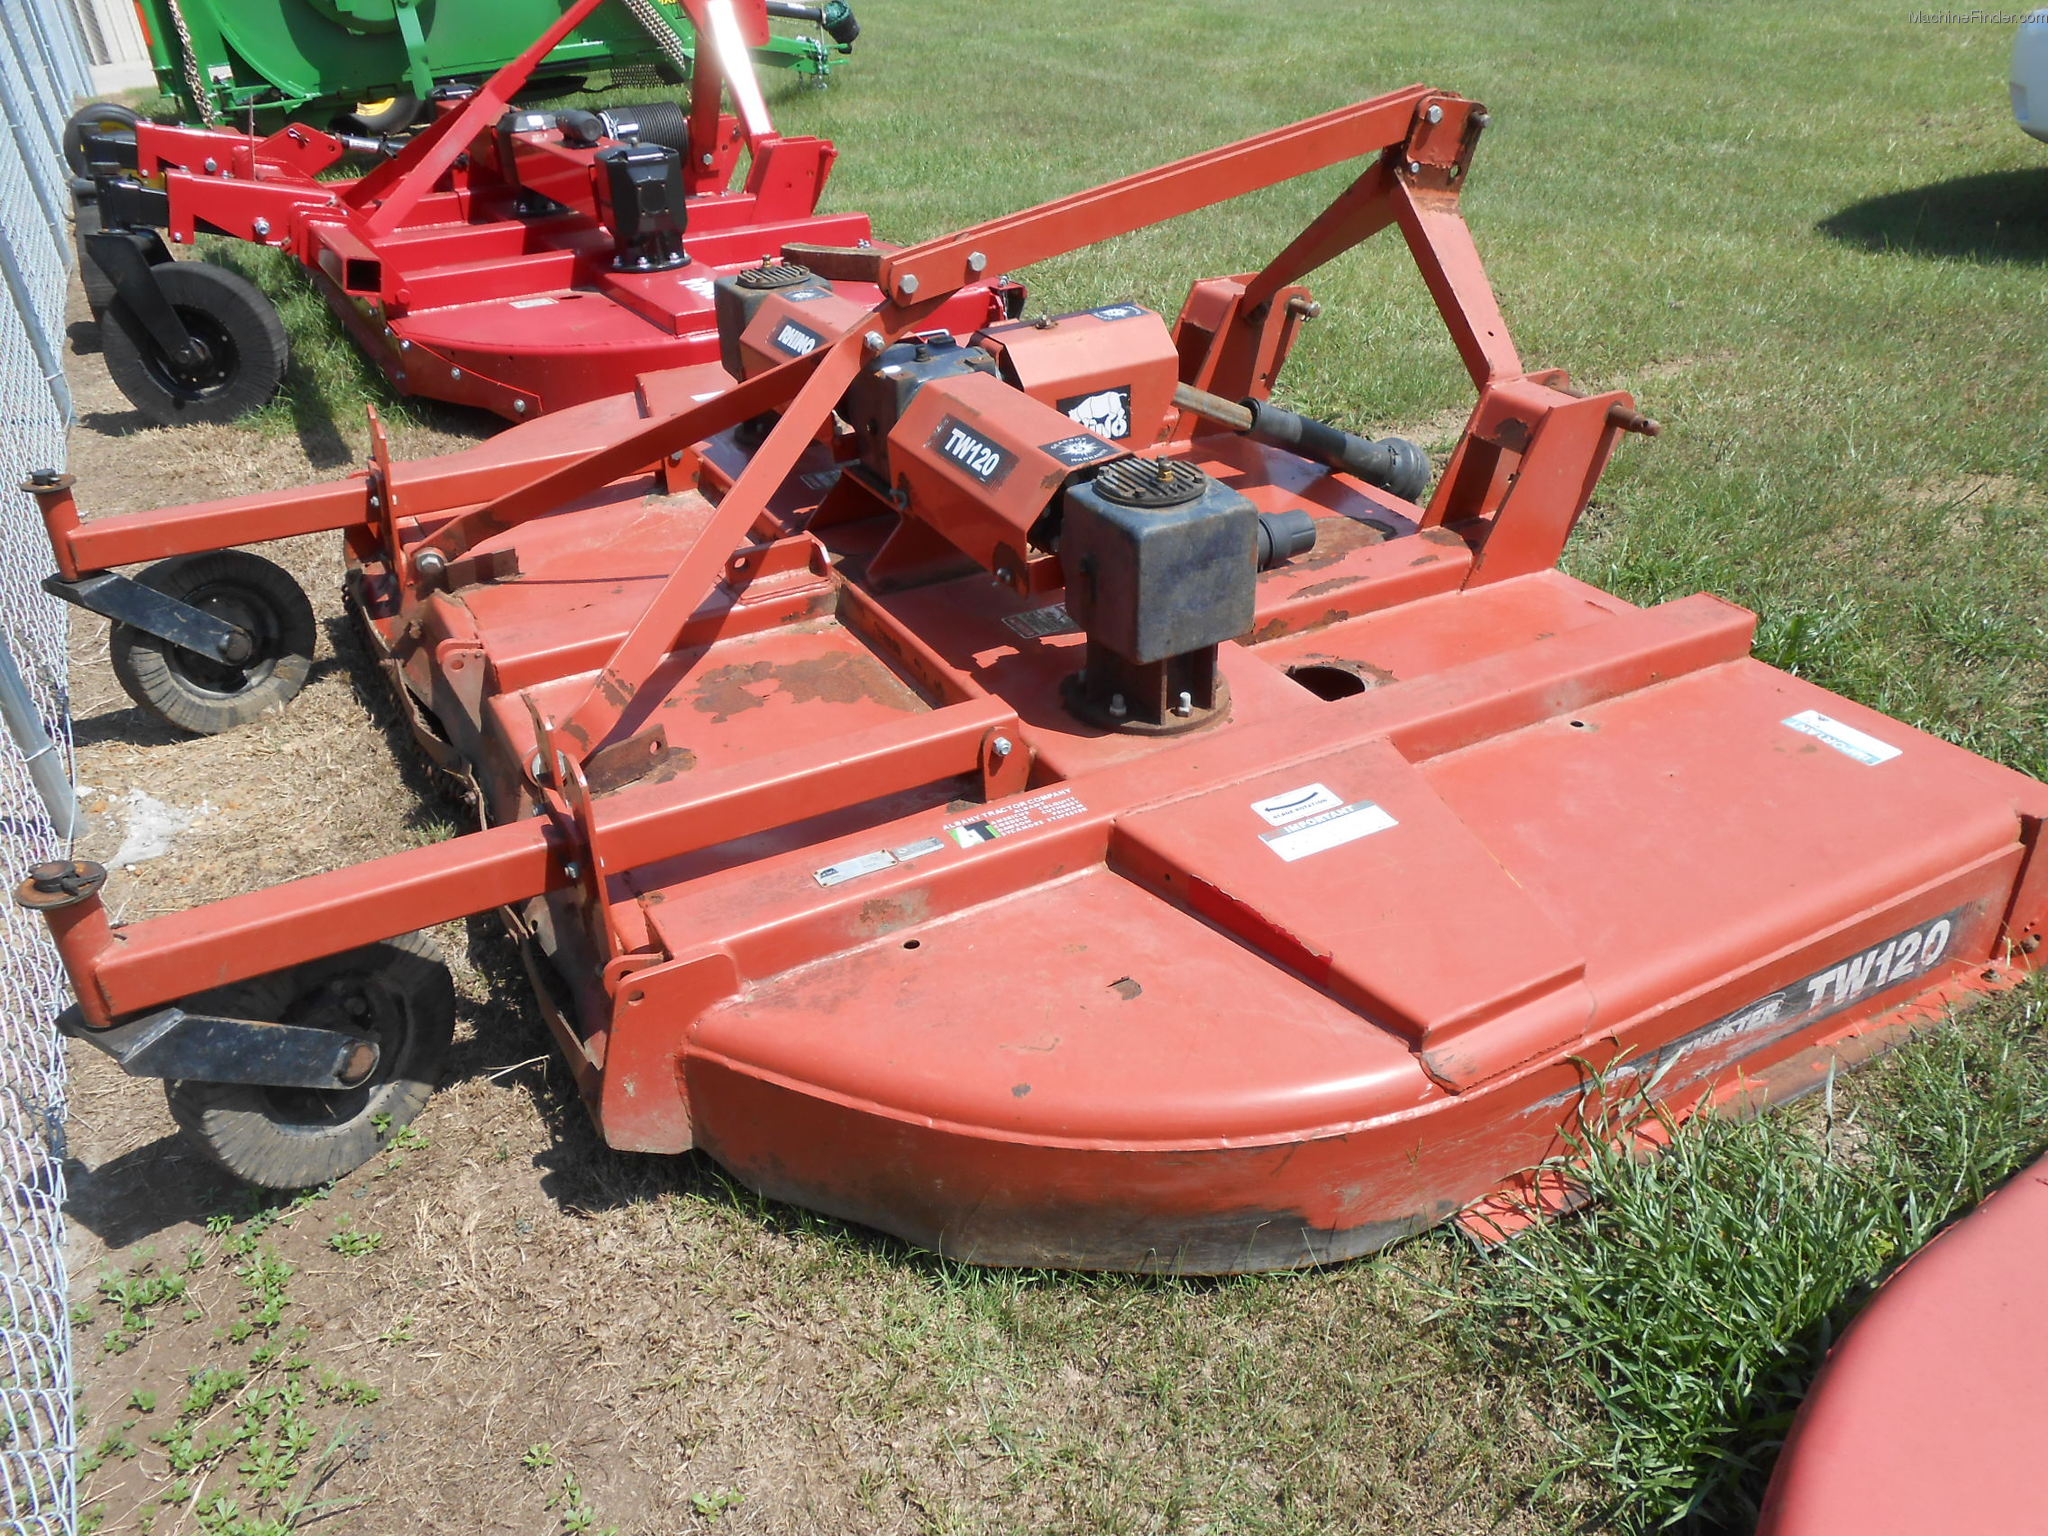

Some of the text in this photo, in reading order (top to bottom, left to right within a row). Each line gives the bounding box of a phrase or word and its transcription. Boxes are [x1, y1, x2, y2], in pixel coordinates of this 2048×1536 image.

[778, 324, 816, 355] RHINO
[944, 428, 1000, 476] TW120
[942, 788, 1072, 831] ALBANY TRACTOR COMPANY
[1285, 805, 1354, 834] IMPORTANT
[1807, 919, 1951, 1015] TW120
